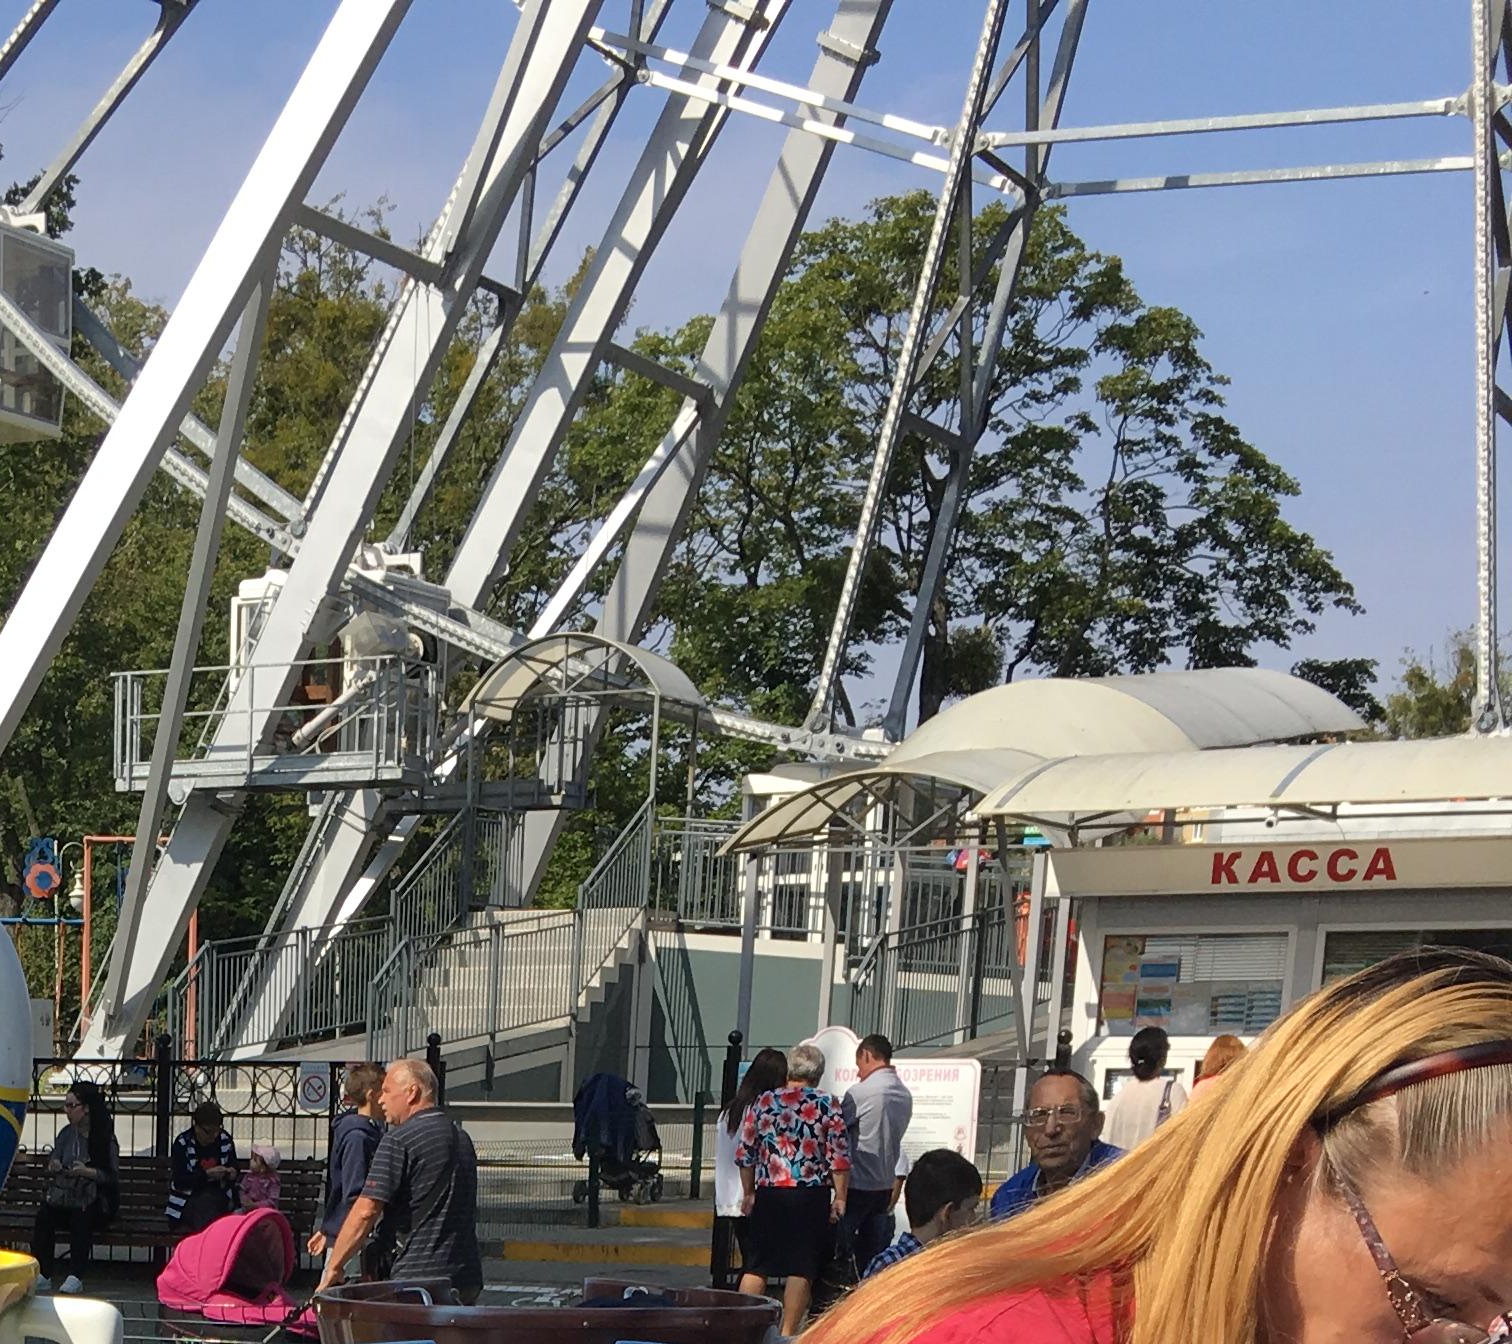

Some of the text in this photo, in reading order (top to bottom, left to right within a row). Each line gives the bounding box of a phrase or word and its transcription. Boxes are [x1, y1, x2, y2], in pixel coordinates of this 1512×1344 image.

[1211, 848, 1397, 884] КАССА
[835, 1068, 960, 1082] КОЛ БОЗРЕНИЯ
